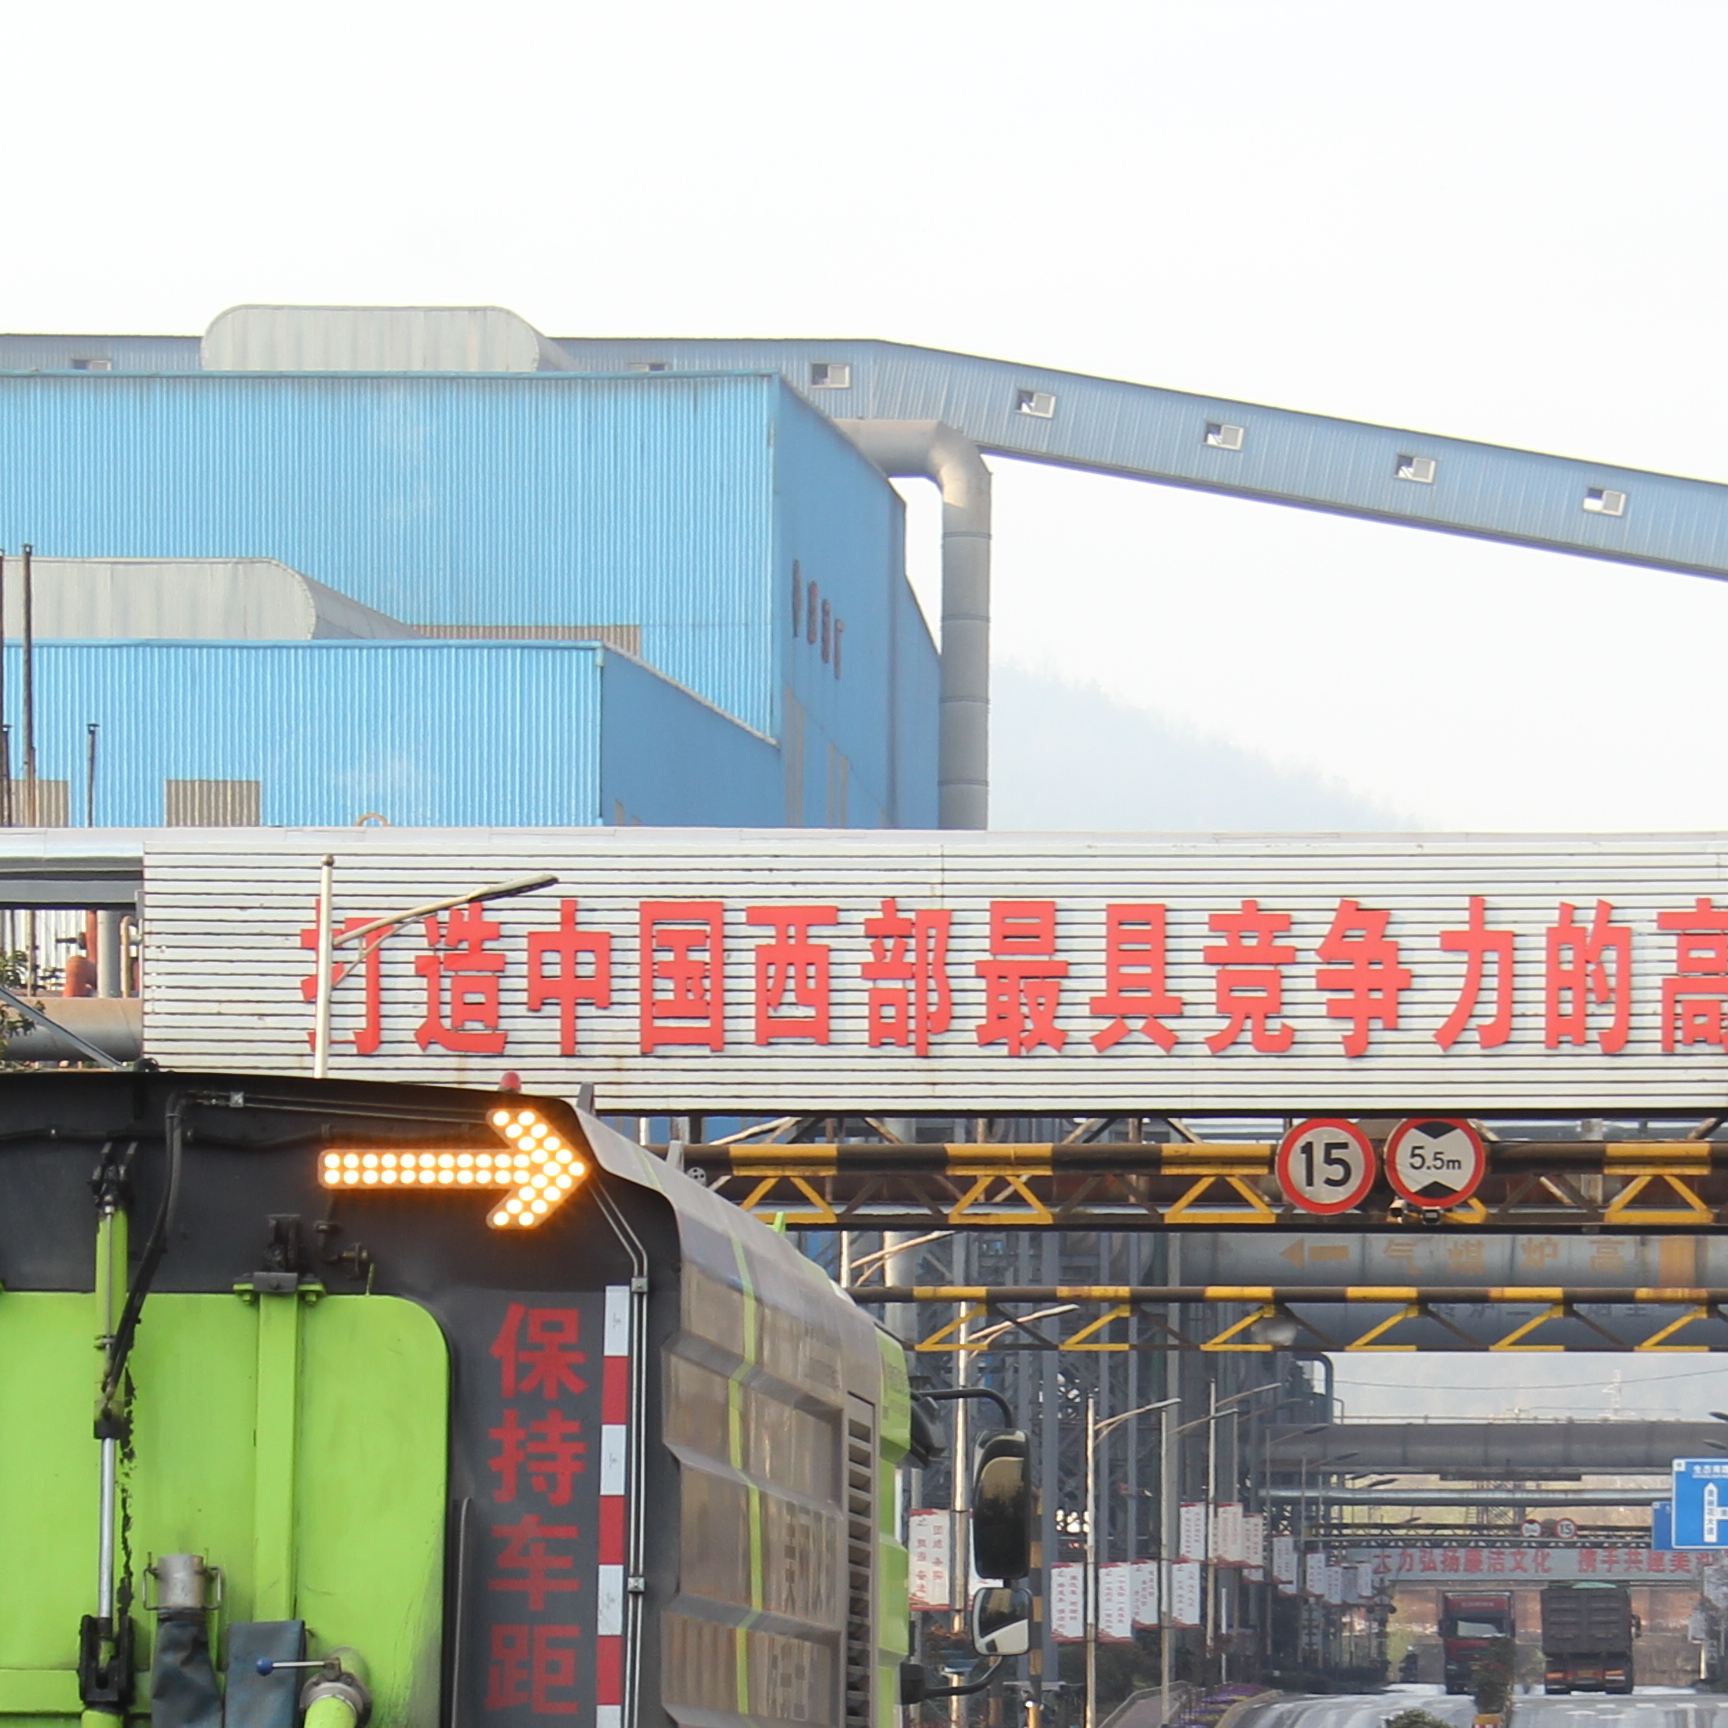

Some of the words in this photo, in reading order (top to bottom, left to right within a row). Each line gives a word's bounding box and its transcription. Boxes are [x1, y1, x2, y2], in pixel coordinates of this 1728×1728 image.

[1300, 1141, 1352, 1187] 15
[1409, 1145, 1462, 1170] 5.5m
[483, 1302, 591, 1716] 保持车距
